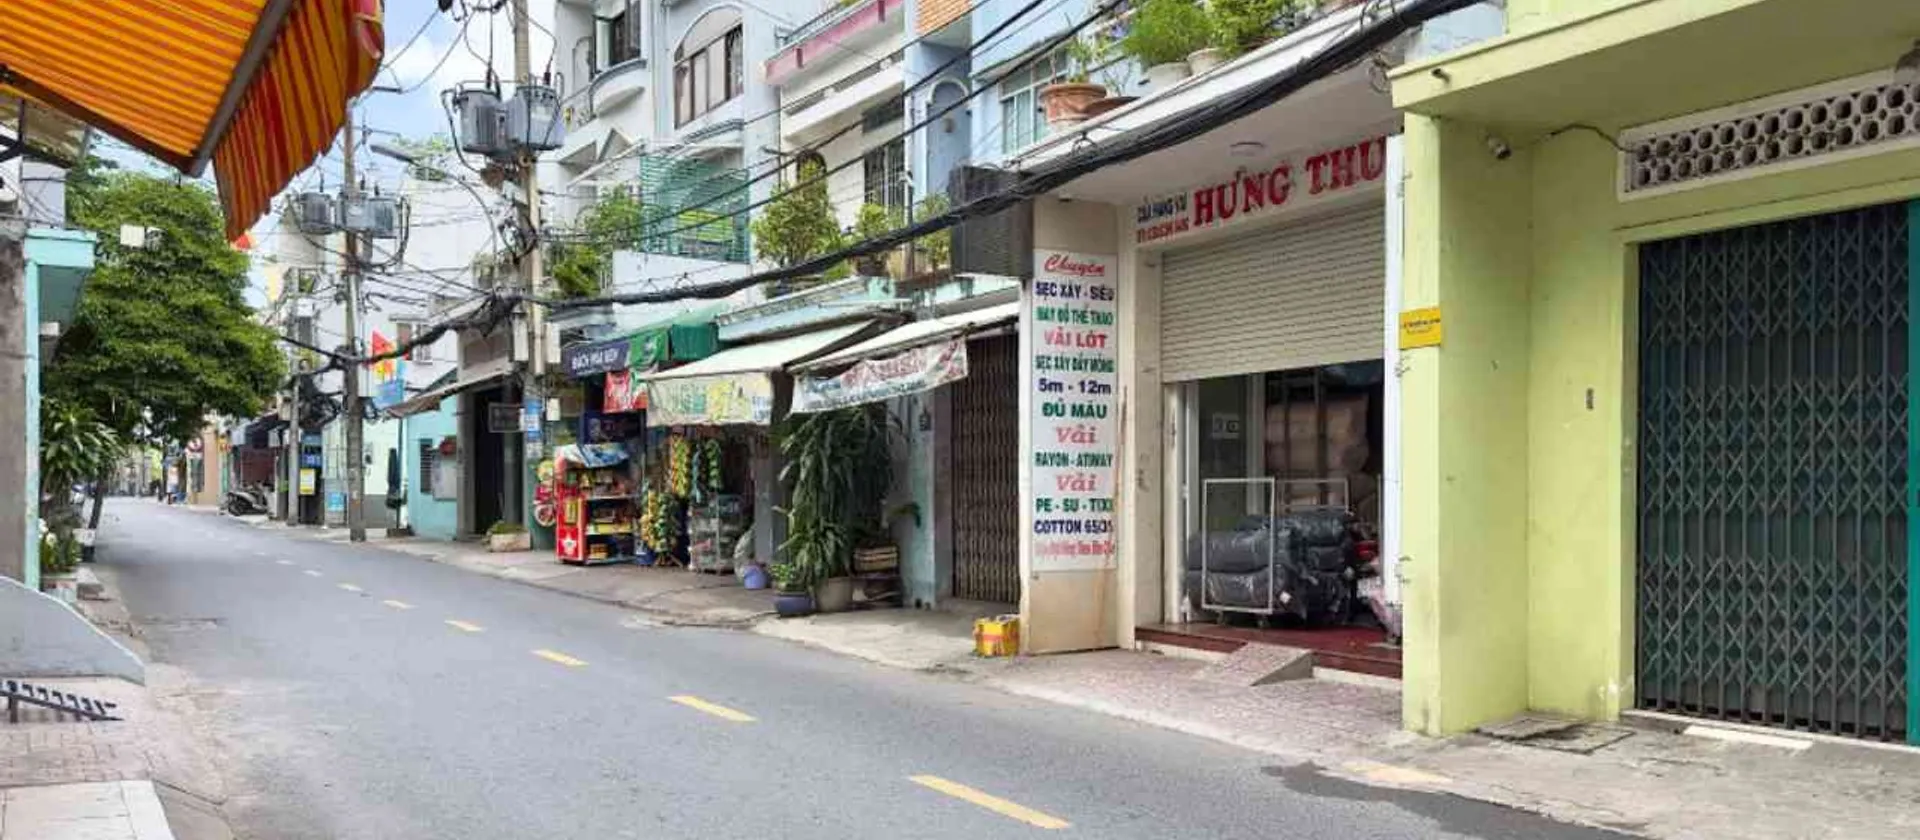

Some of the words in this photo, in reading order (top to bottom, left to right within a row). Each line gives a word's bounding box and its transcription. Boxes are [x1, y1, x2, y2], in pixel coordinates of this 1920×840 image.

[1038, 378, 1063, 394] 5m
[1079, 380, 1111, 395] 12m
[1036, 498, 1052, 512] PE
[1034, 519, 1081, 534] COTTON
